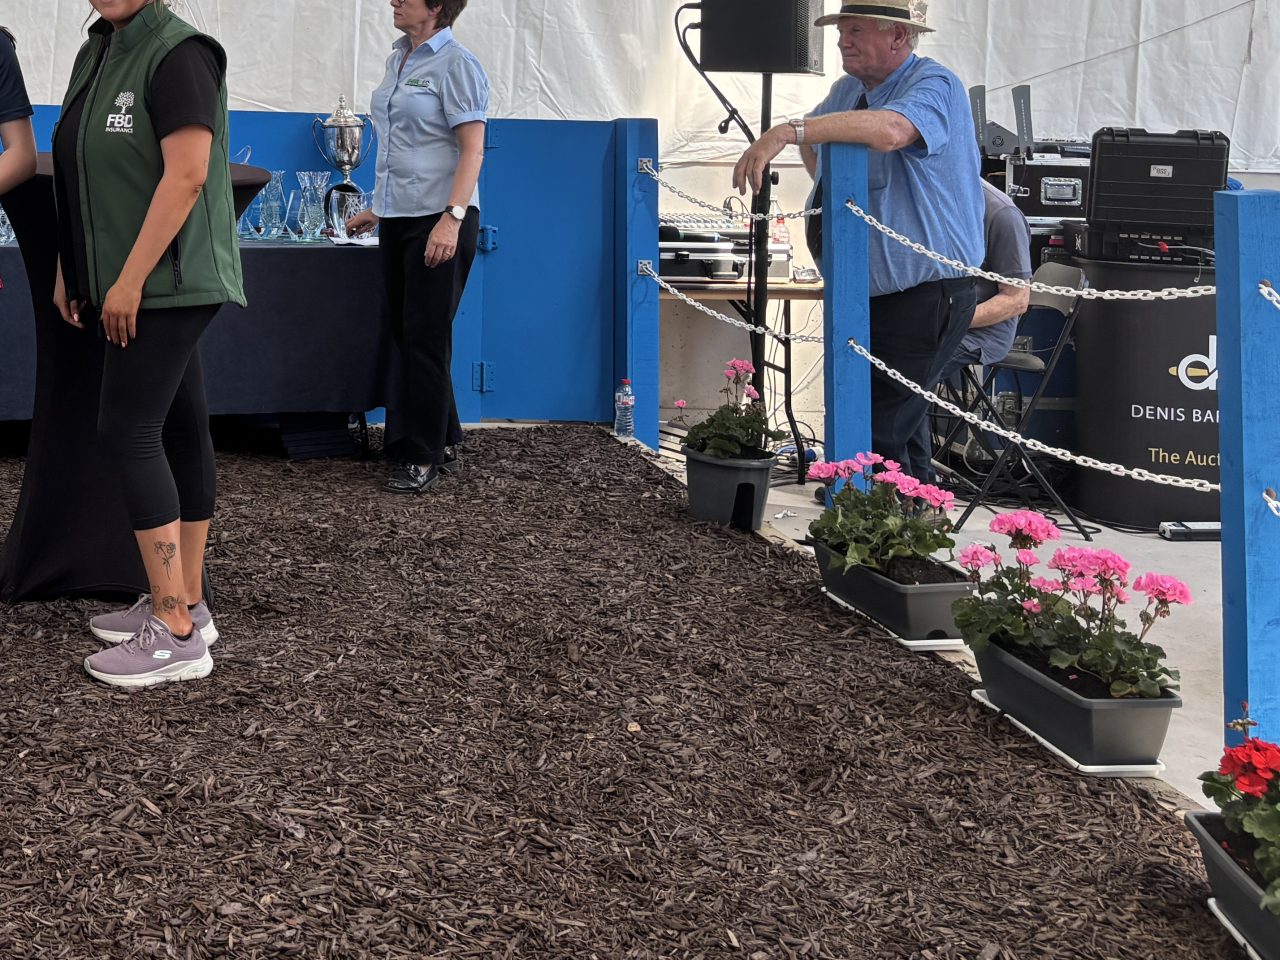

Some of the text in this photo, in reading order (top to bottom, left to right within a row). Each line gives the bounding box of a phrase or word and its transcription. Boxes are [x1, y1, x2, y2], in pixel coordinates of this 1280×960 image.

[106, 113, 134, 128] FBD
[1131, 404, 1186, 422] DENIS
[1148, 447, 1181, 464] The
